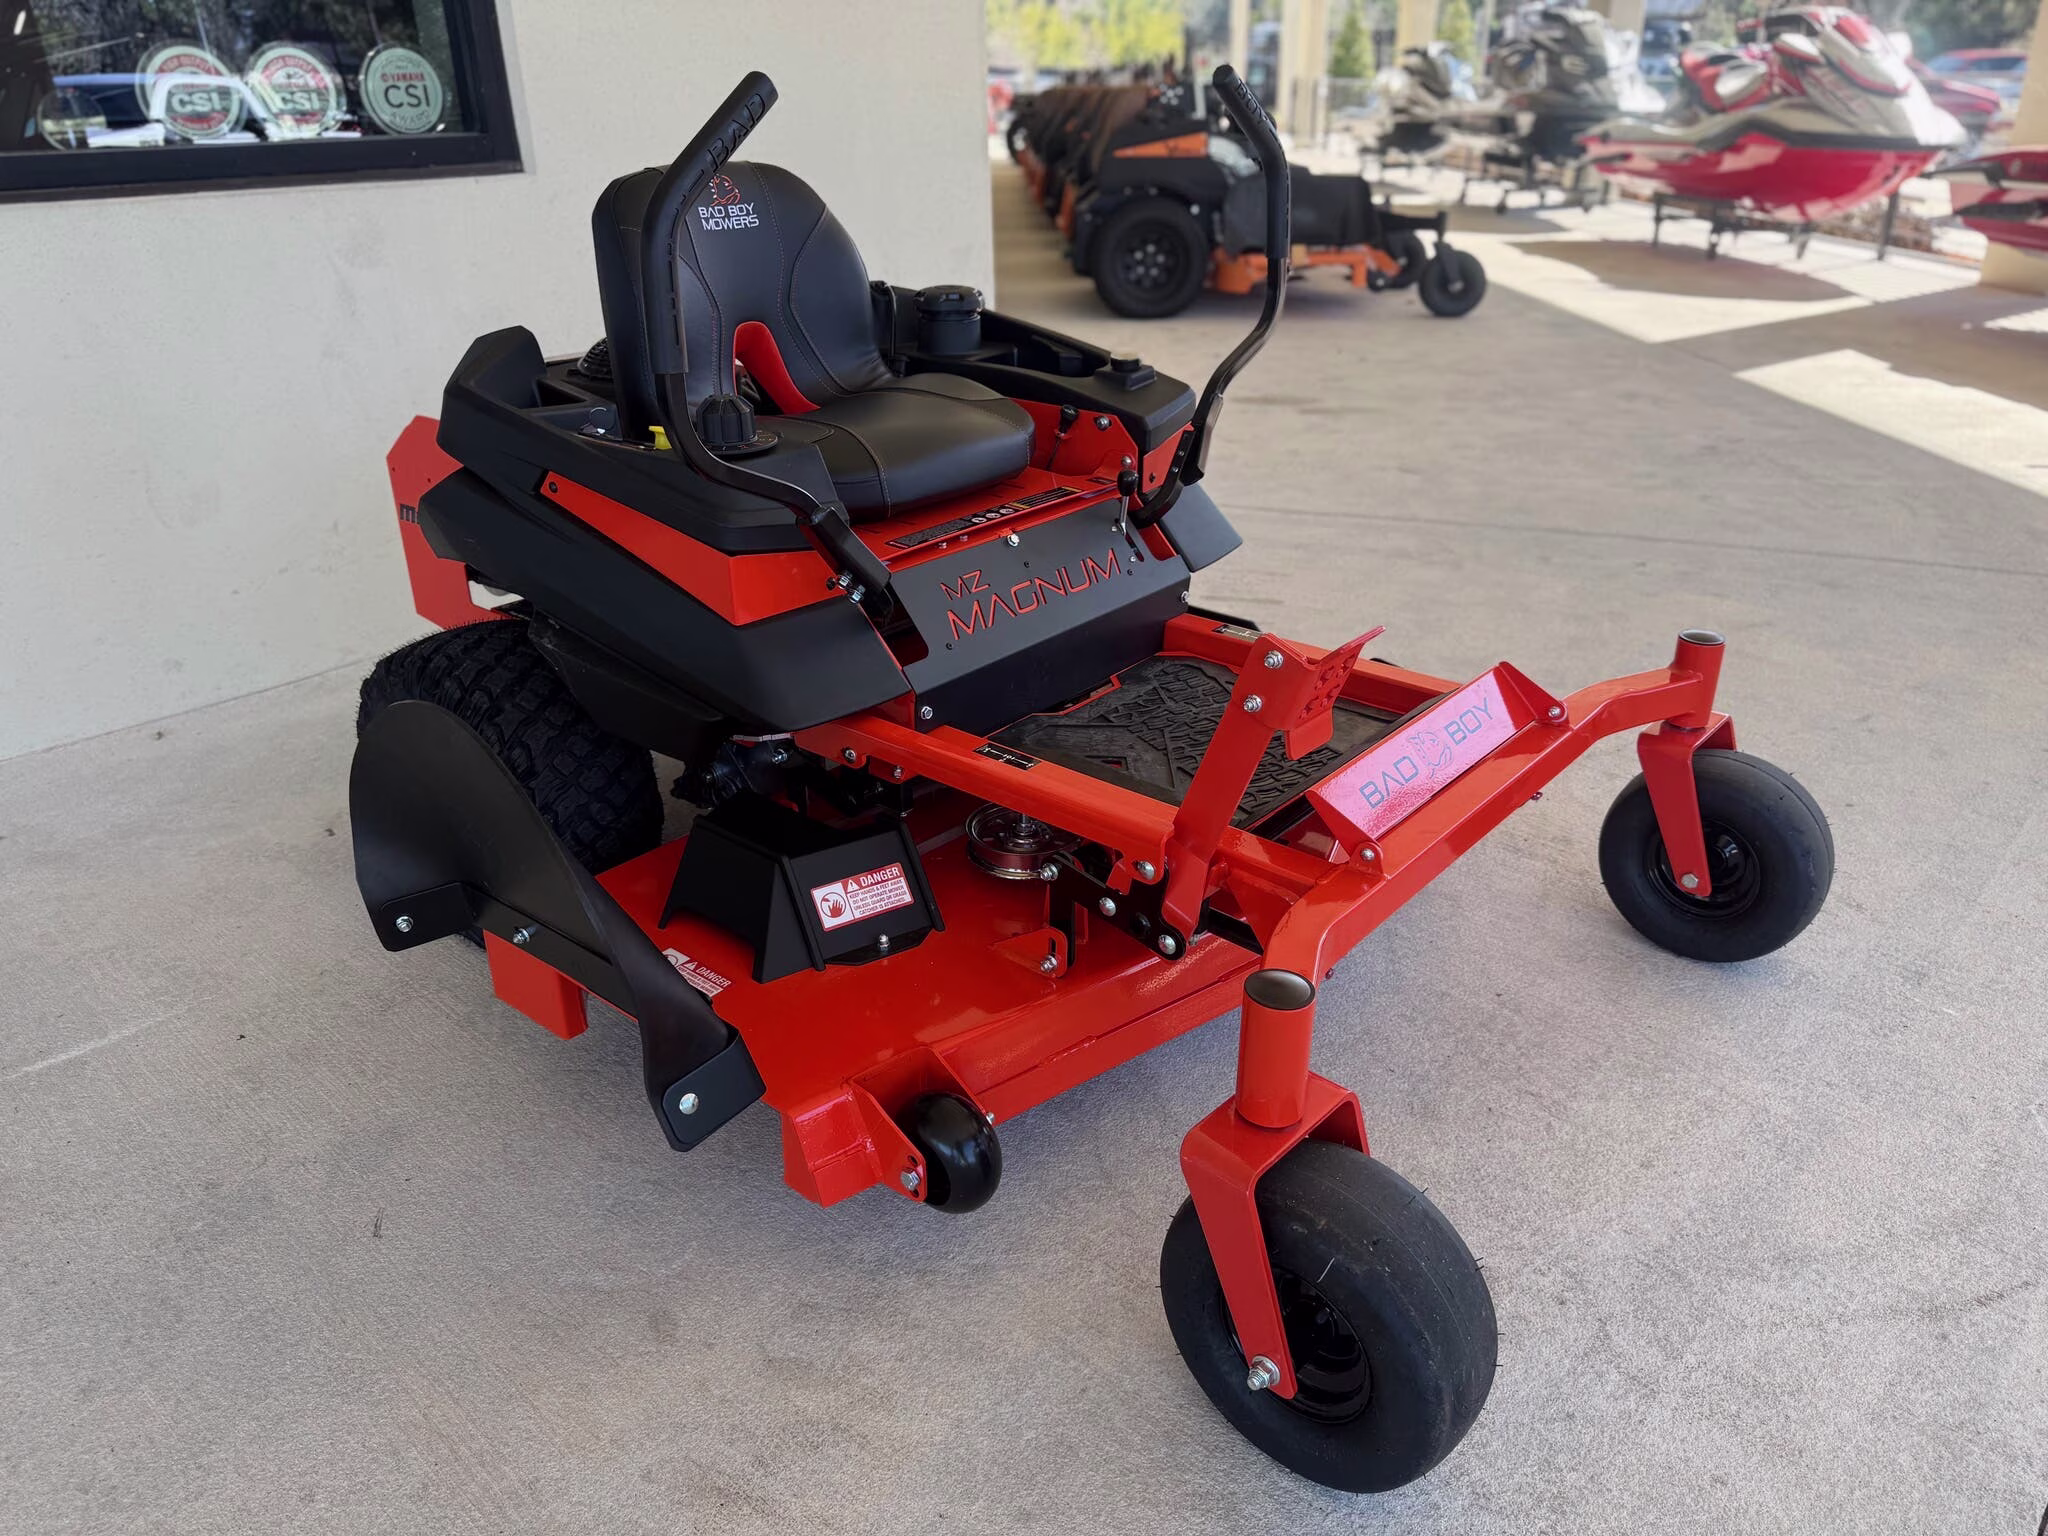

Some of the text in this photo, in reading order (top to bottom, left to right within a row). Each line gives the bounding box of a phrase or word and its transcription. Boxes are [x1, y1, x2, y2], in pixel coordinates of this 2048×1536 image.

[170, 91, 222, 113] CSI
[278, 91, 320, 111] CSI
[384, 84, 430, 108] CSI
[698, 203, 754, 218] BAD BOY
[701, 215, 759, 231] MOWERS
[940, 569, 990, 601] MZ
[947, 547, 1121, 641] MAGNUM
[1359, 697, 1493, 809] BAD BOY
[860, 867, 900, 887] DANGER
[695, 966, 732, 988] DANGER
